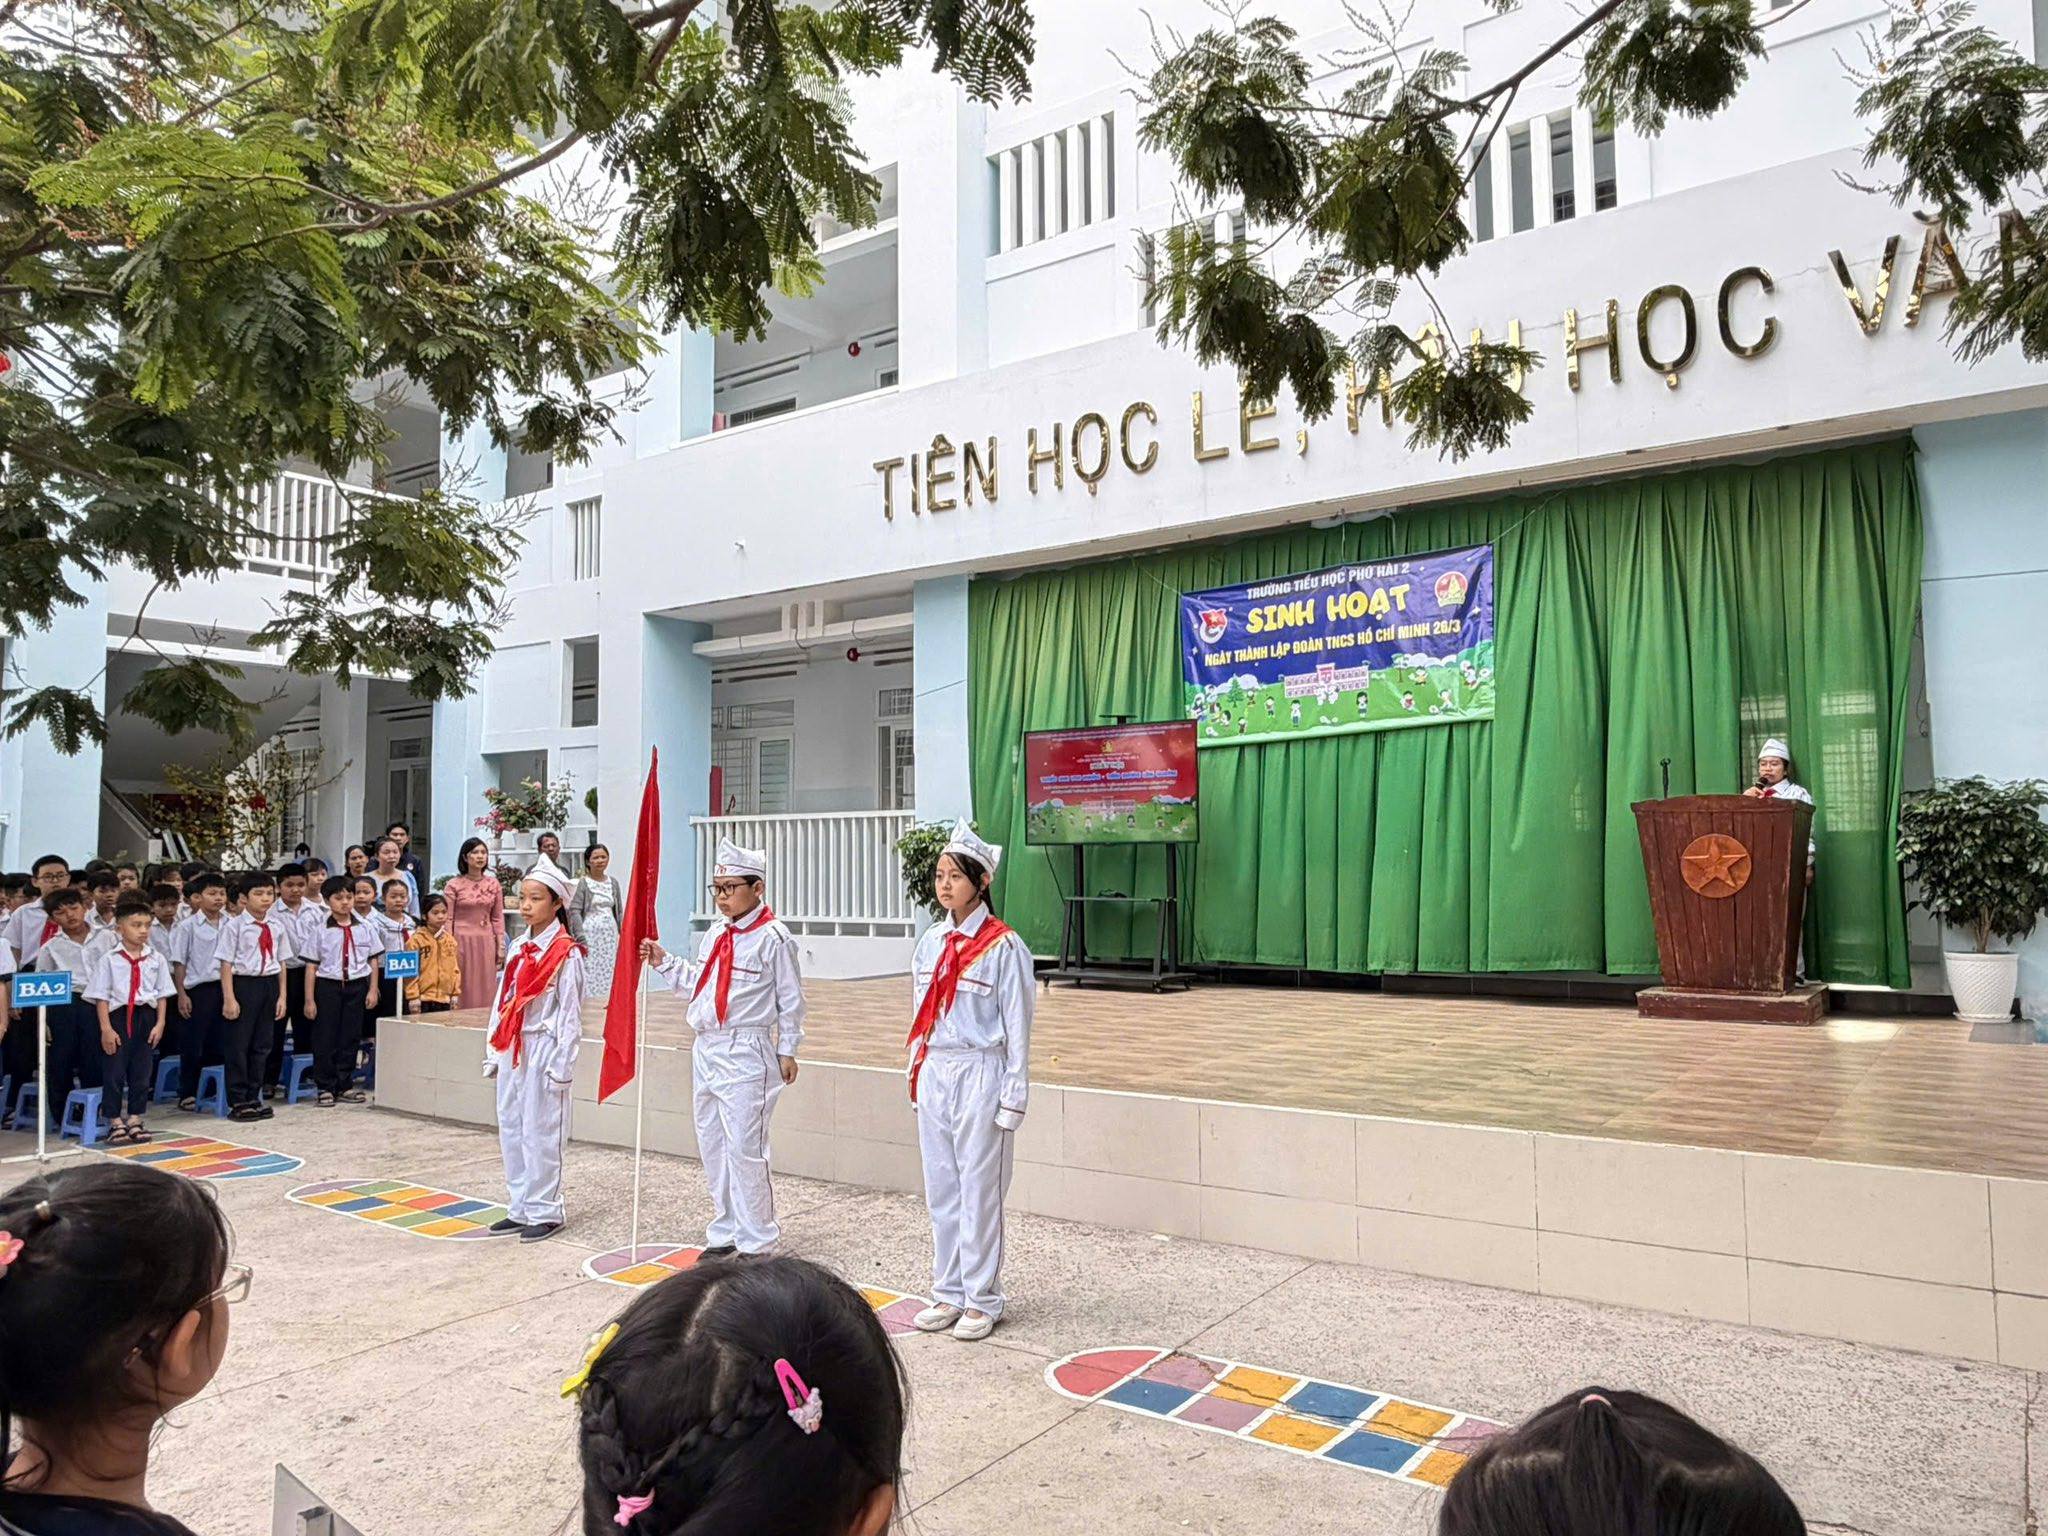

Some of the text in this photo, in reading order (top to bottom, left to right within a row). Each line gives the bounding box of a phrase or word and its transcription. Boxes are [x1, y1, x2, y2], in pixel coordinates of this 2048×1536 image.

[873, 433, 999, 520] TIÊN
[1028, 401, 1159, 496] HỌC
[1564, 265, 1779, 391] HỌC
[1321, 571, 1346, 589] HỌC
[1401, 562, 1410, 575] 2
[1246, 583, 1410, 634] SINH HOẠT
[1204, 650, 1232, 667] NGÀY
[1234, 645, 1268, 663] THÀNH
[1270, 641, 1290, 659] LẬP
[1292, 637, 1323, 654] ĐOÀN
[1325, 633, 1355, 650] TNCS
[1375, 624, 1395, 643] CHÍ
[1398, 622, 1430, 639] MINH
[388, 958, 416, 971] BA1
[18, 981, 66, 998] BA2
